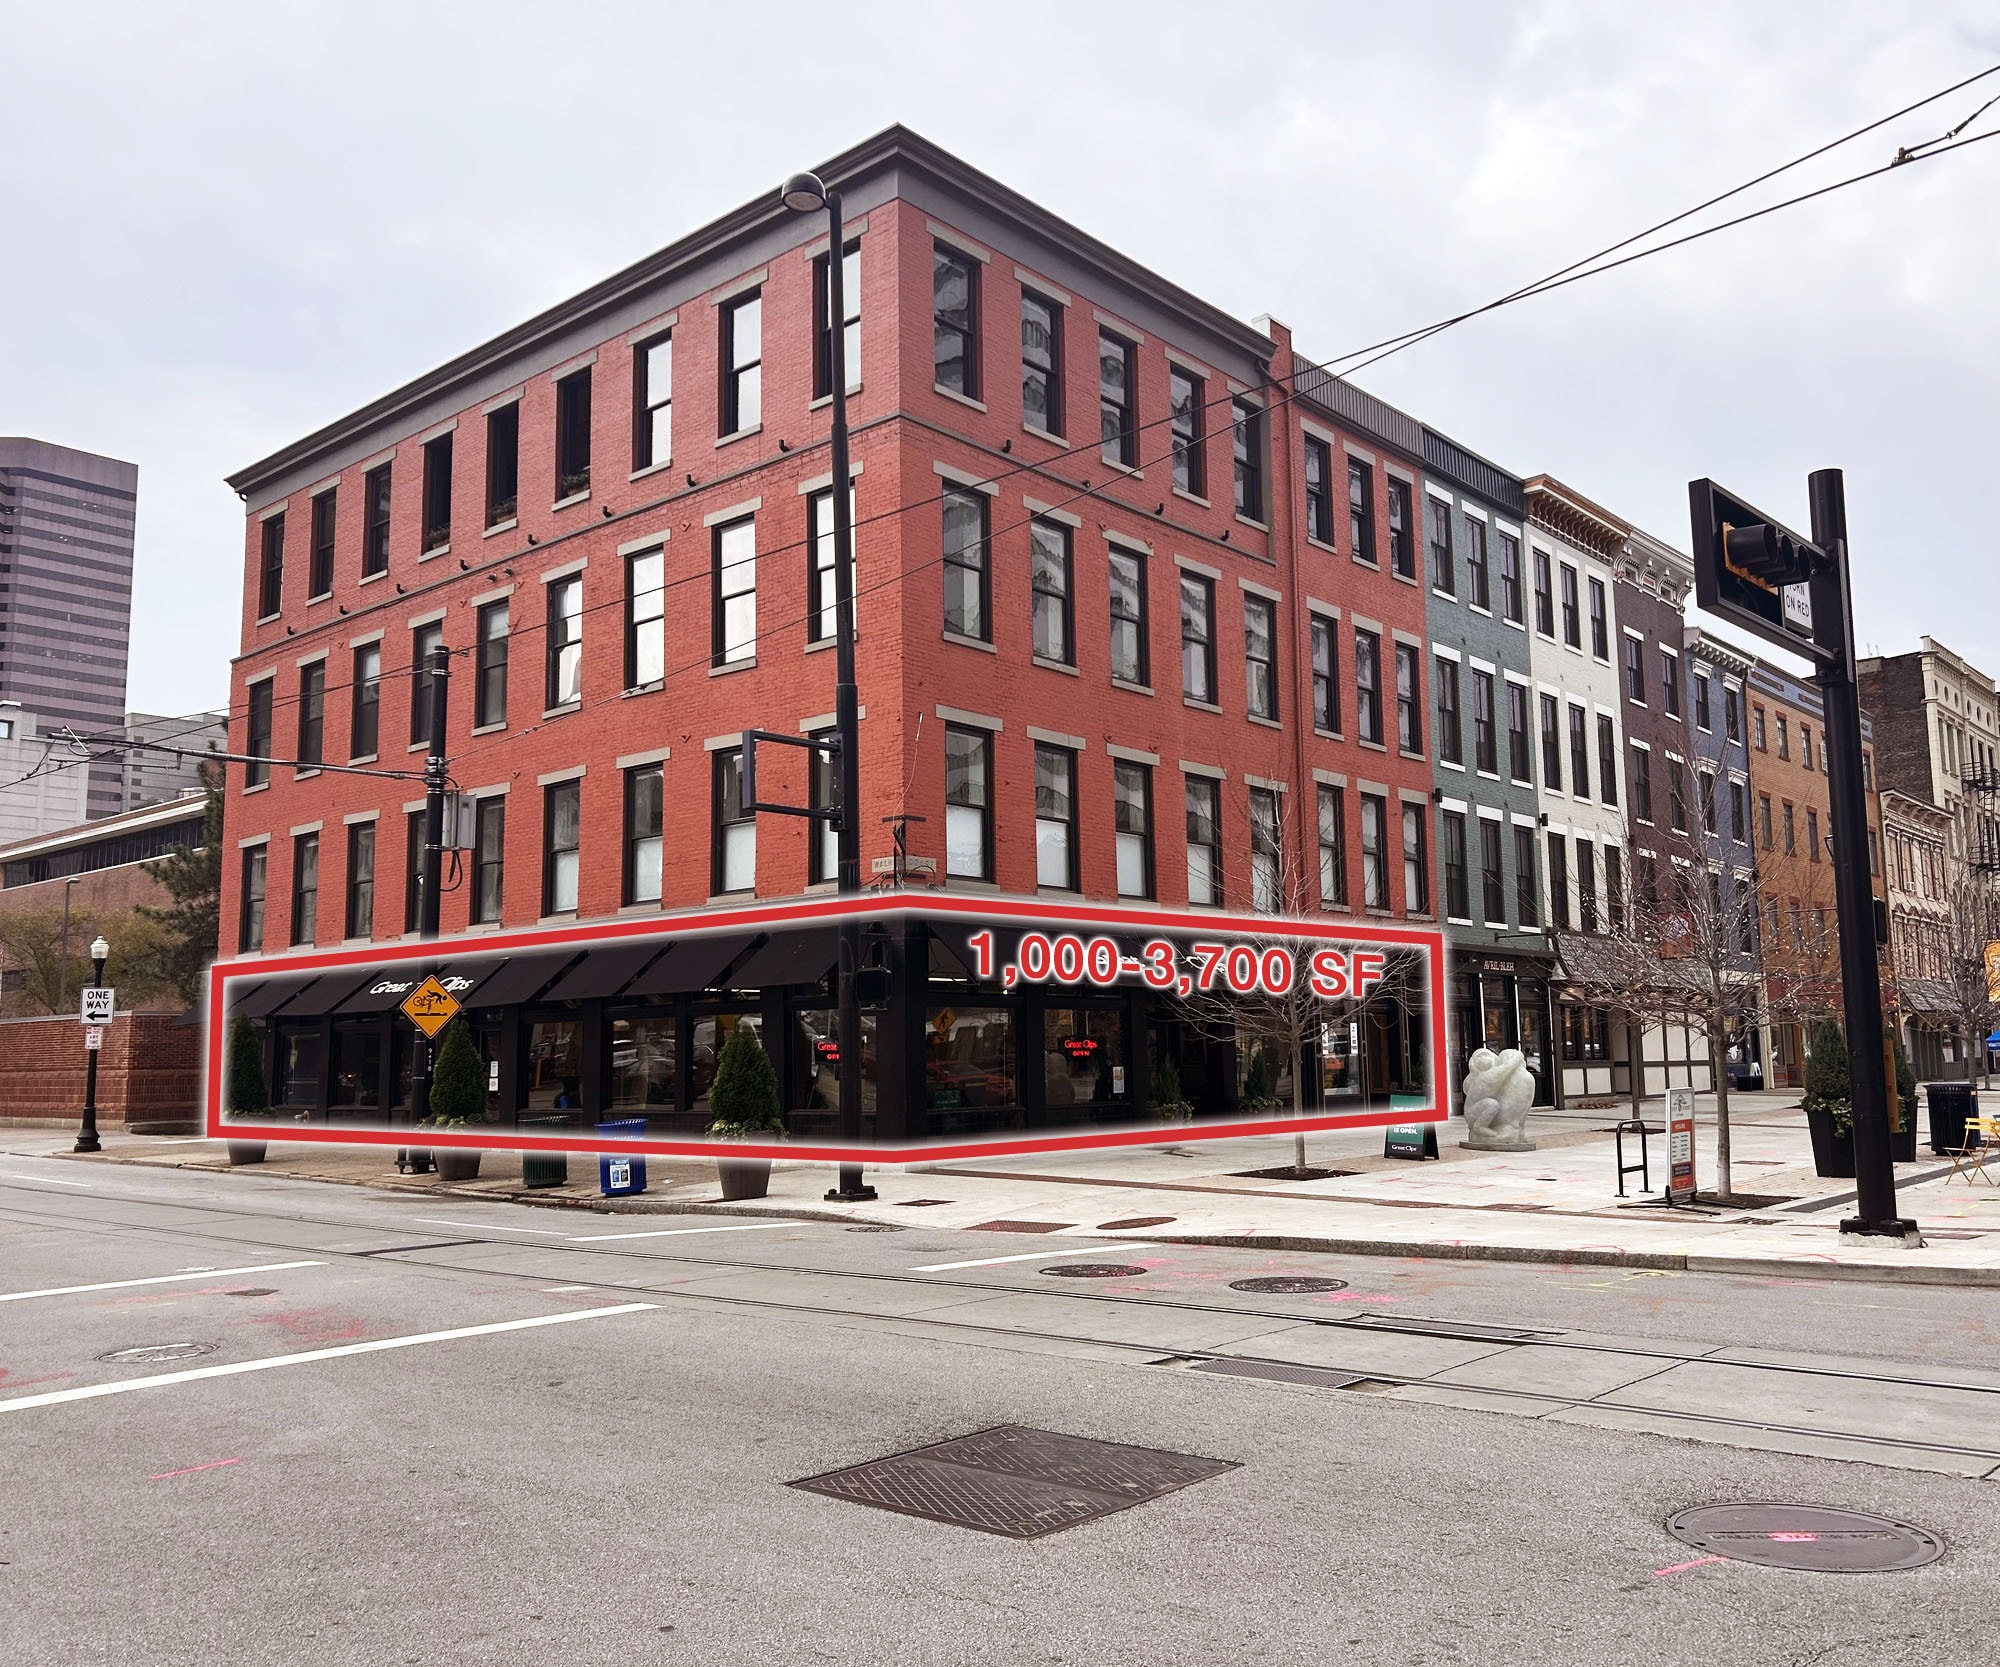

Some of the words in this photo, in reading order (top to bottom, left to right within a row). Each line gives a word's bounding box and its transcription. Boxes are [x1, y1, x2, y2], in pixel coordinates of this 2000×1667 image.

[1786, 594, 1796, 611] ON
[1797, 599, 1809, 617] RED
[370, 981, 414, 994] Great
[87, 991, 109, 999] ONE
[86, 1001, 109, 1009] WAY
[1064, 1040, 1082, 1048] Great
[1082, 1040, 1098, 1050] Clips
